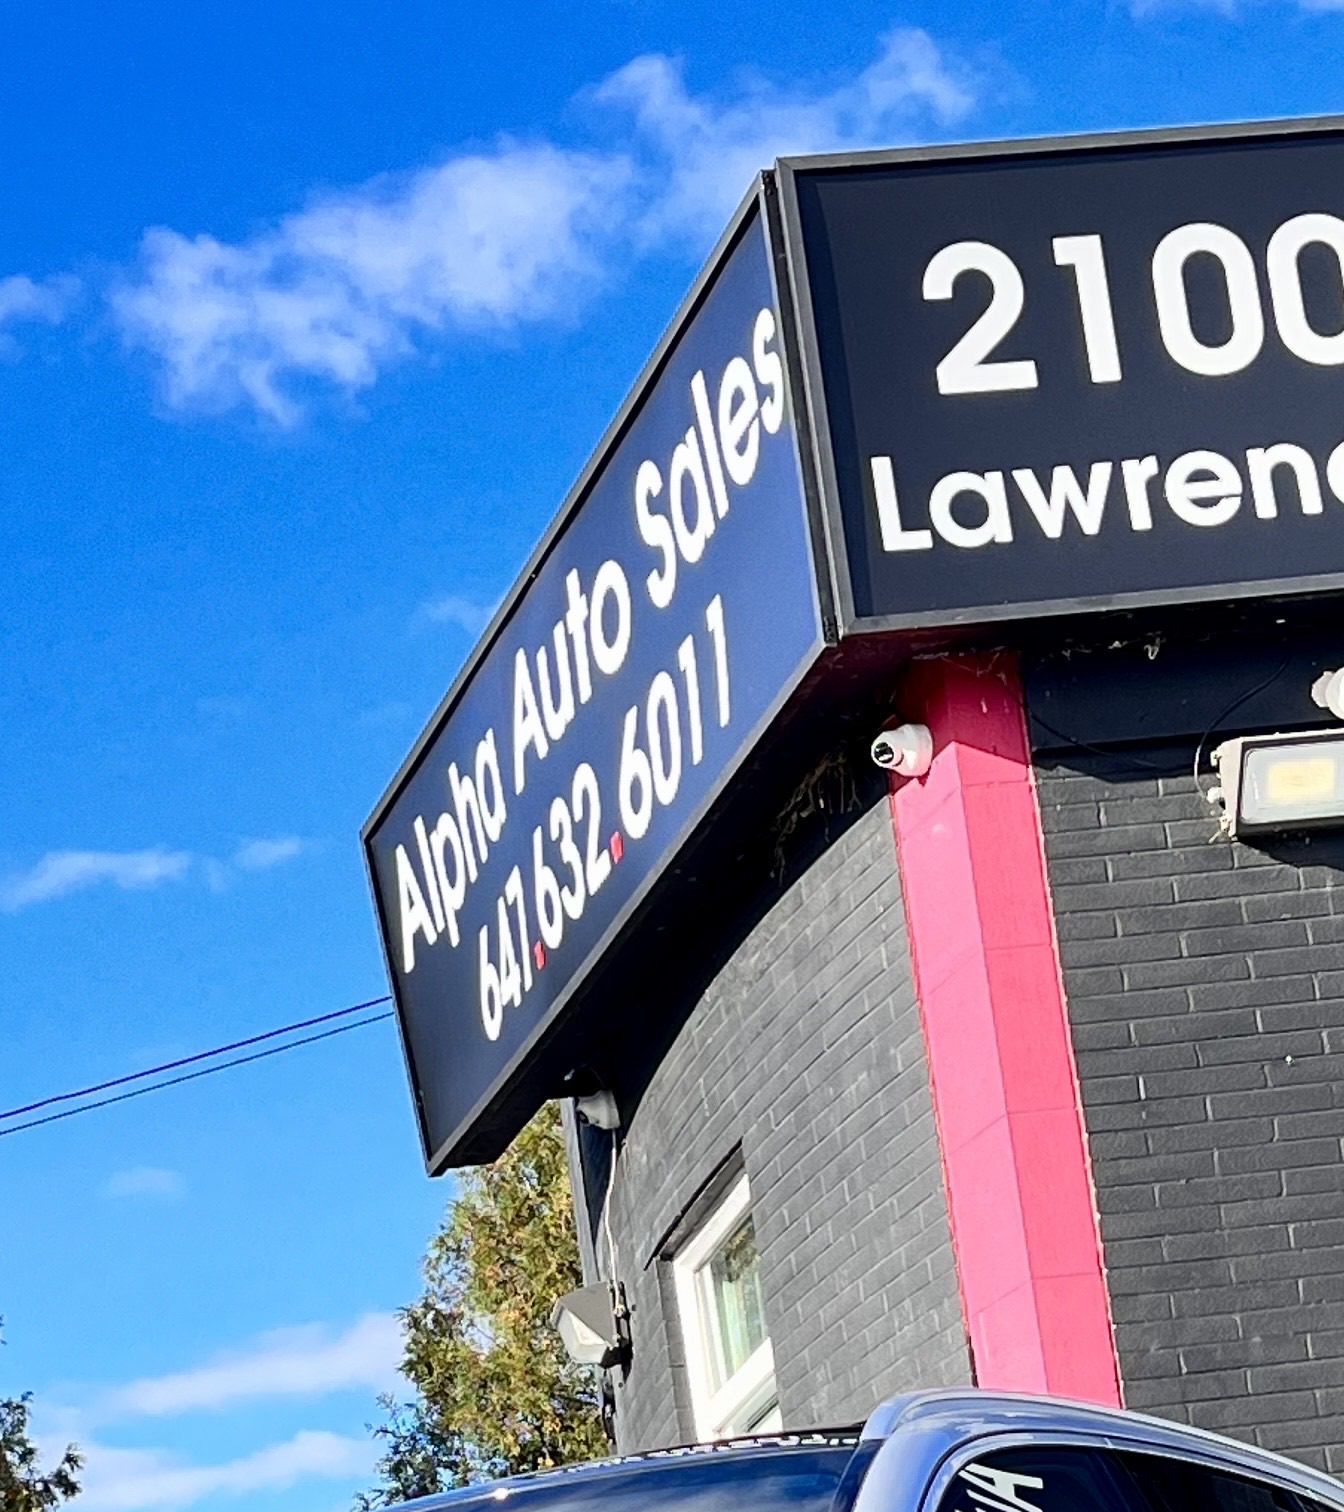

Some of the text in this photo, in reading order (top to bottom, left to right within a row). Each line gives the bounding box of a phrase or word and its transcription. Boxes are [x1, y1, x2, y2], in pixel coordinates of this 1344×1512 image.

[395, 307, 785, 974] Alpha Auto Sales
[479, 593, 731, 1042] 647.632.6011
